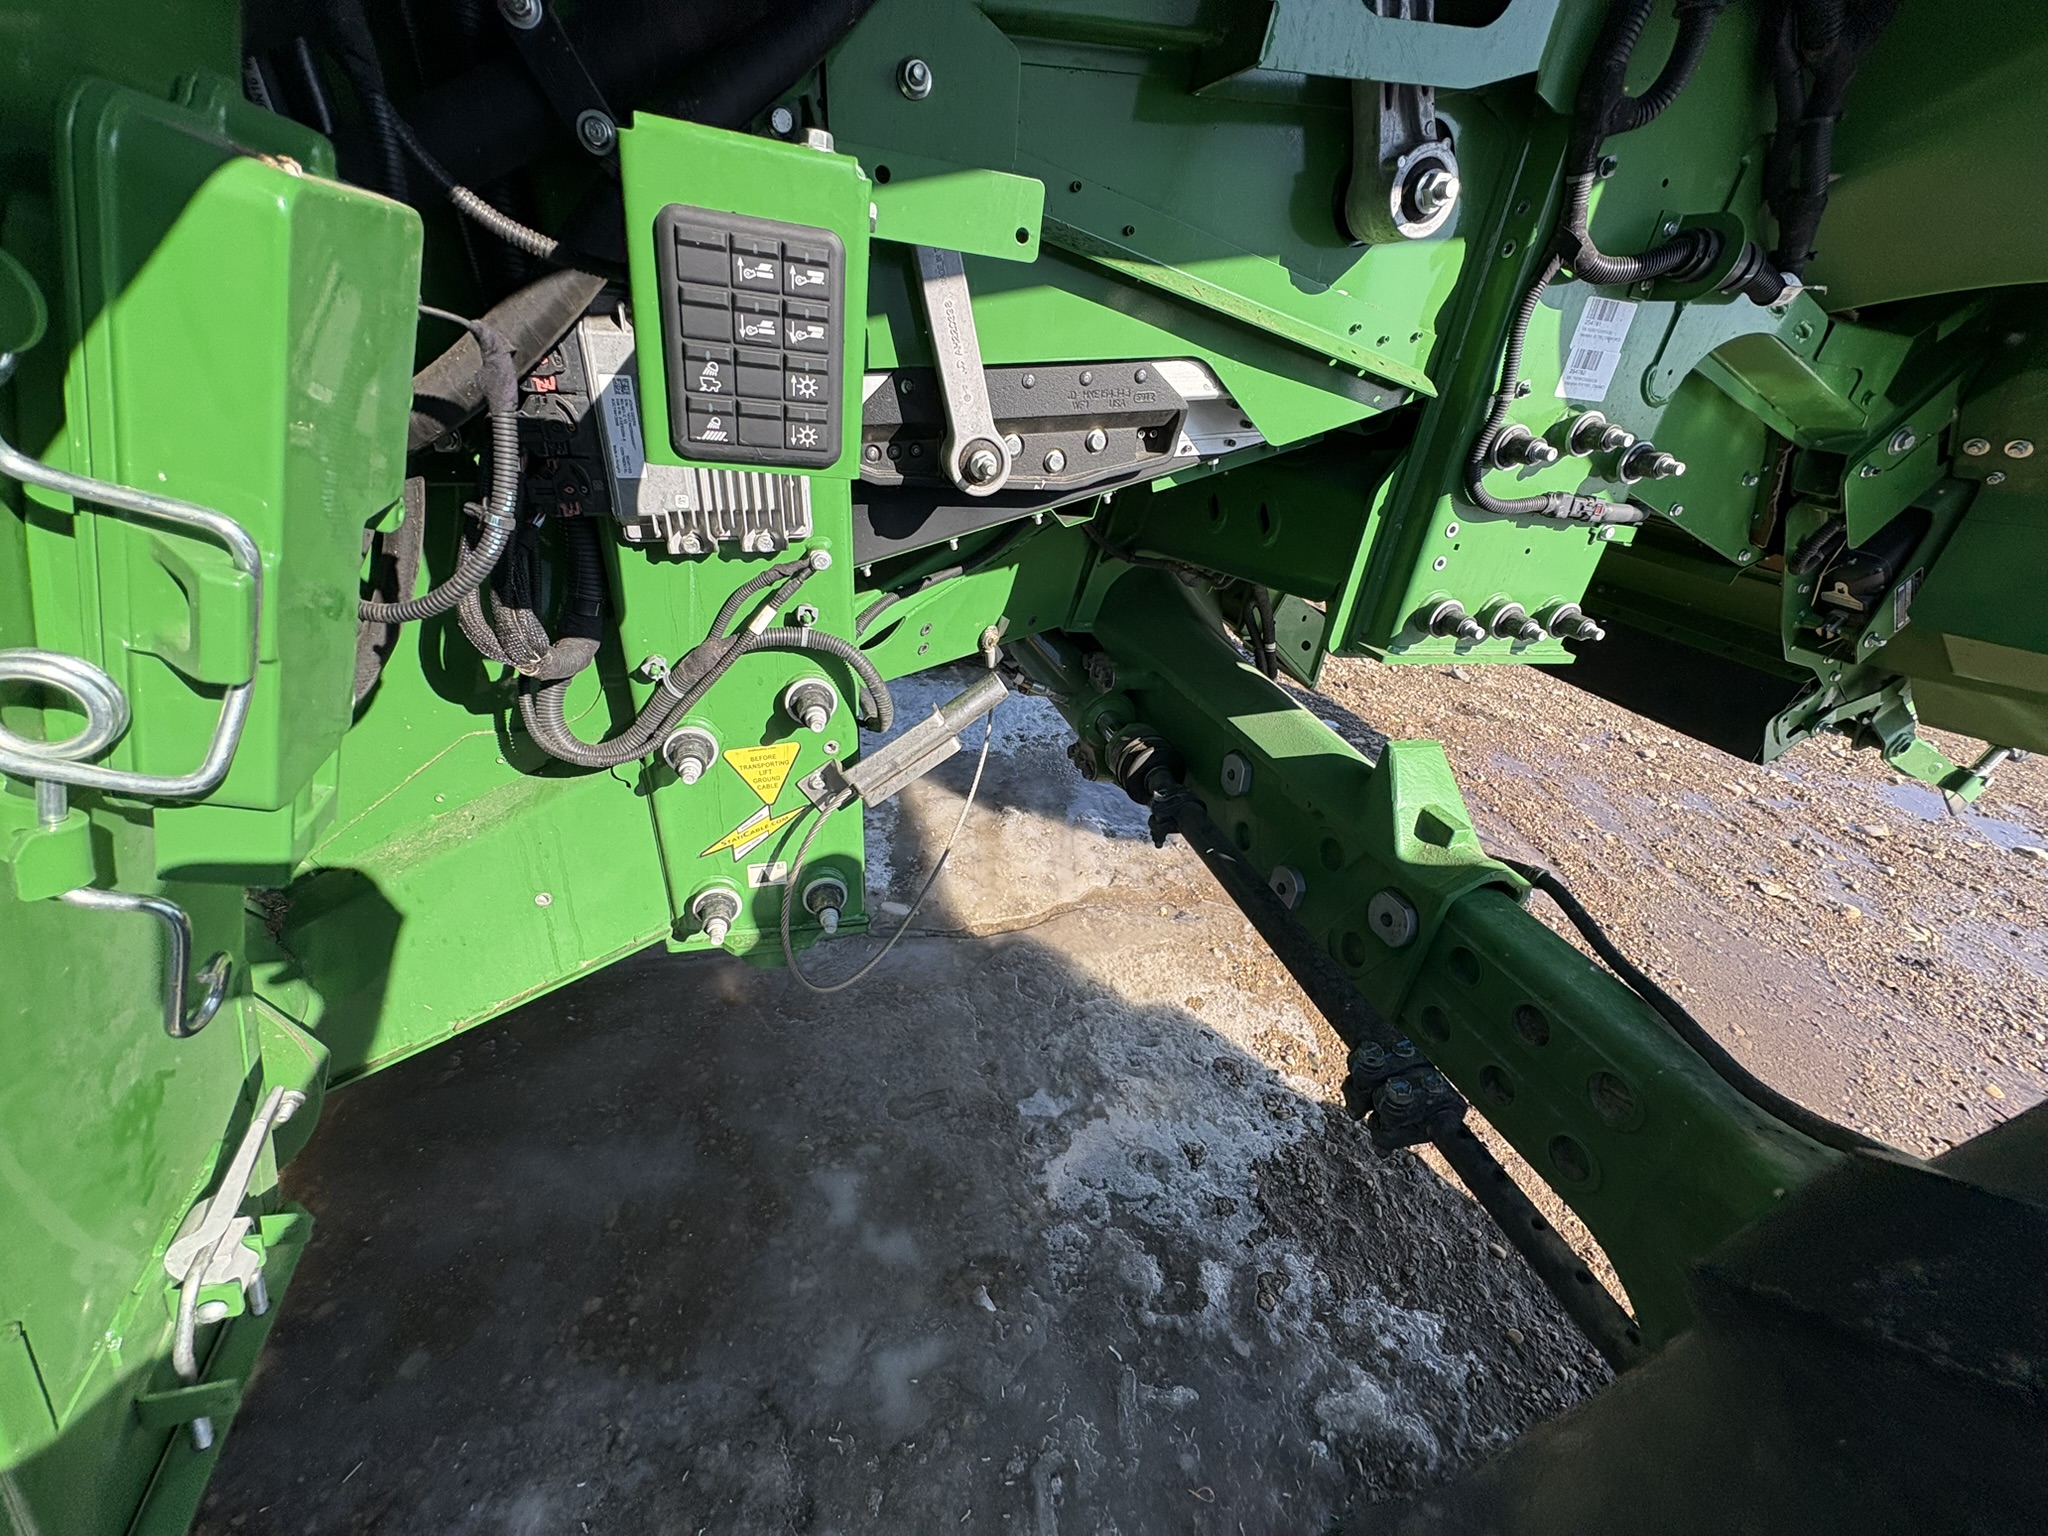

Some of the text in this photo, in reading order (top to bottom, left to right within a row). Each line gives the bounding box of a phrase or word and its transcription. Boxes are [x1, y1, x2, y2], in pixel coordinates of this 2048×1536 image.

[750, 754, 777, 762] BEFORE
[739, 759, 790, 771] TRANSPORTING
[753, 775, 780, 784] GROUND
[757, 782, 778, 791] CABLE
